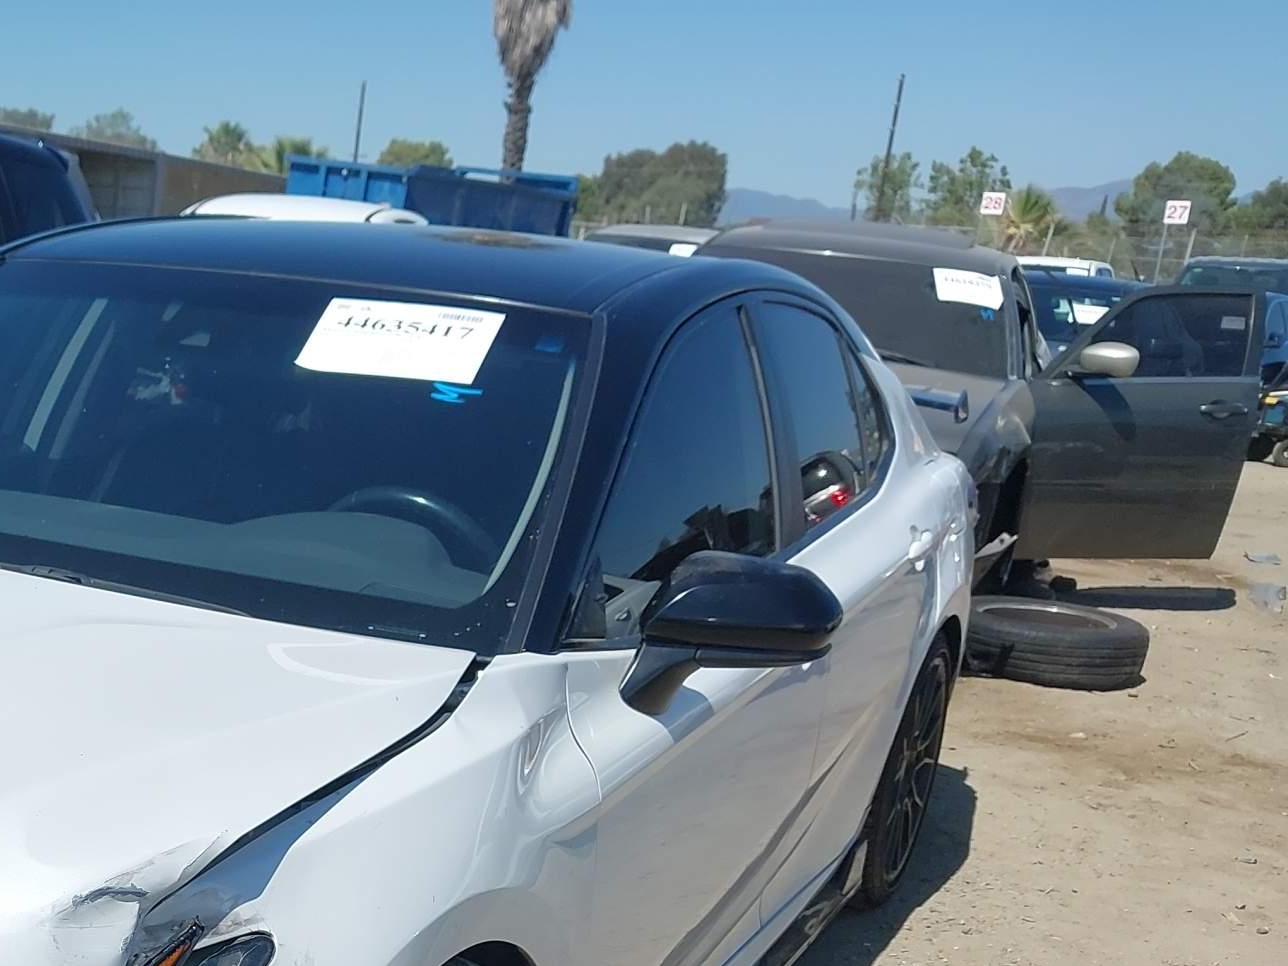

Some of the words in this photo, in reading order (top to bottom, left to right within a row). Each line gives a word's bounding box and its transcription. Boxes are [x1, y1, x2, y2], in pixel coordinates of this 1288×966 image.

[984, 197, 1002, 210] 28
[1167, 205, 1189, 219] 27
[336, 315, 475, 340] 44635417
